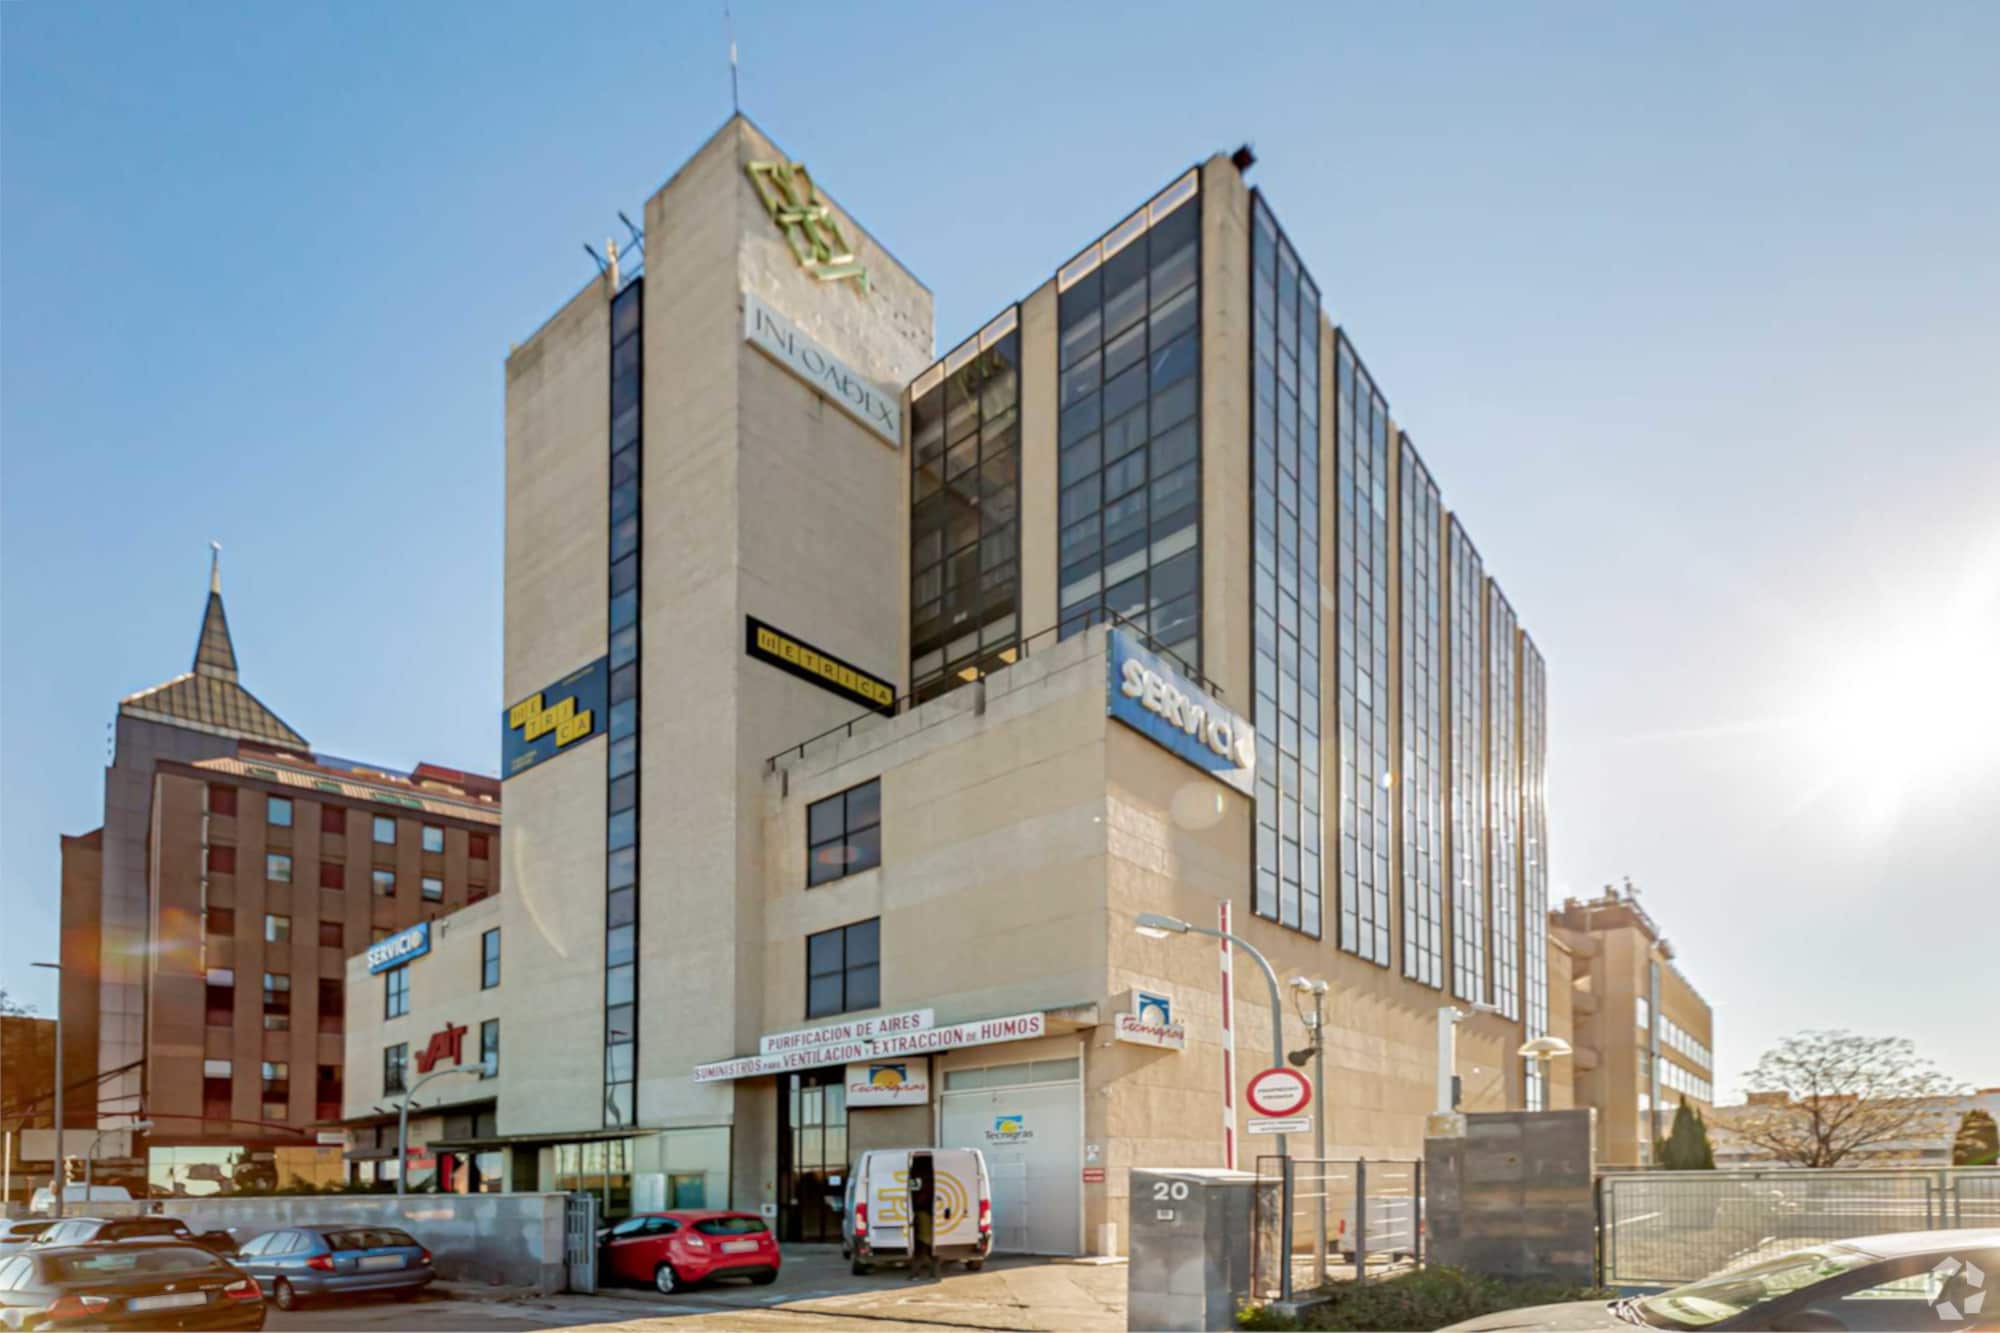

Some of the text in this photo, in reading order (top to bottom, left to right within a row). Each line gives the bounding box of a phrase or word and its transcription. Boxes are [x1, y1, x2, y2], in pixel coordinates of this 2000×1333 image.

[761, 632, 889, 700] METRICA
[695, 1060, 762, 1080] SUMINISTROS
[783, 1041, 861, 1068] VENTILACION
[872, 1028, 964, 1056] EXTRACCION
[980, 1015, 1040, 1041] HUMOS
[768, 1013, 921, 1051] PURIFICACION DE AIRES
[1153, 1181, 1189, 1201] 20
